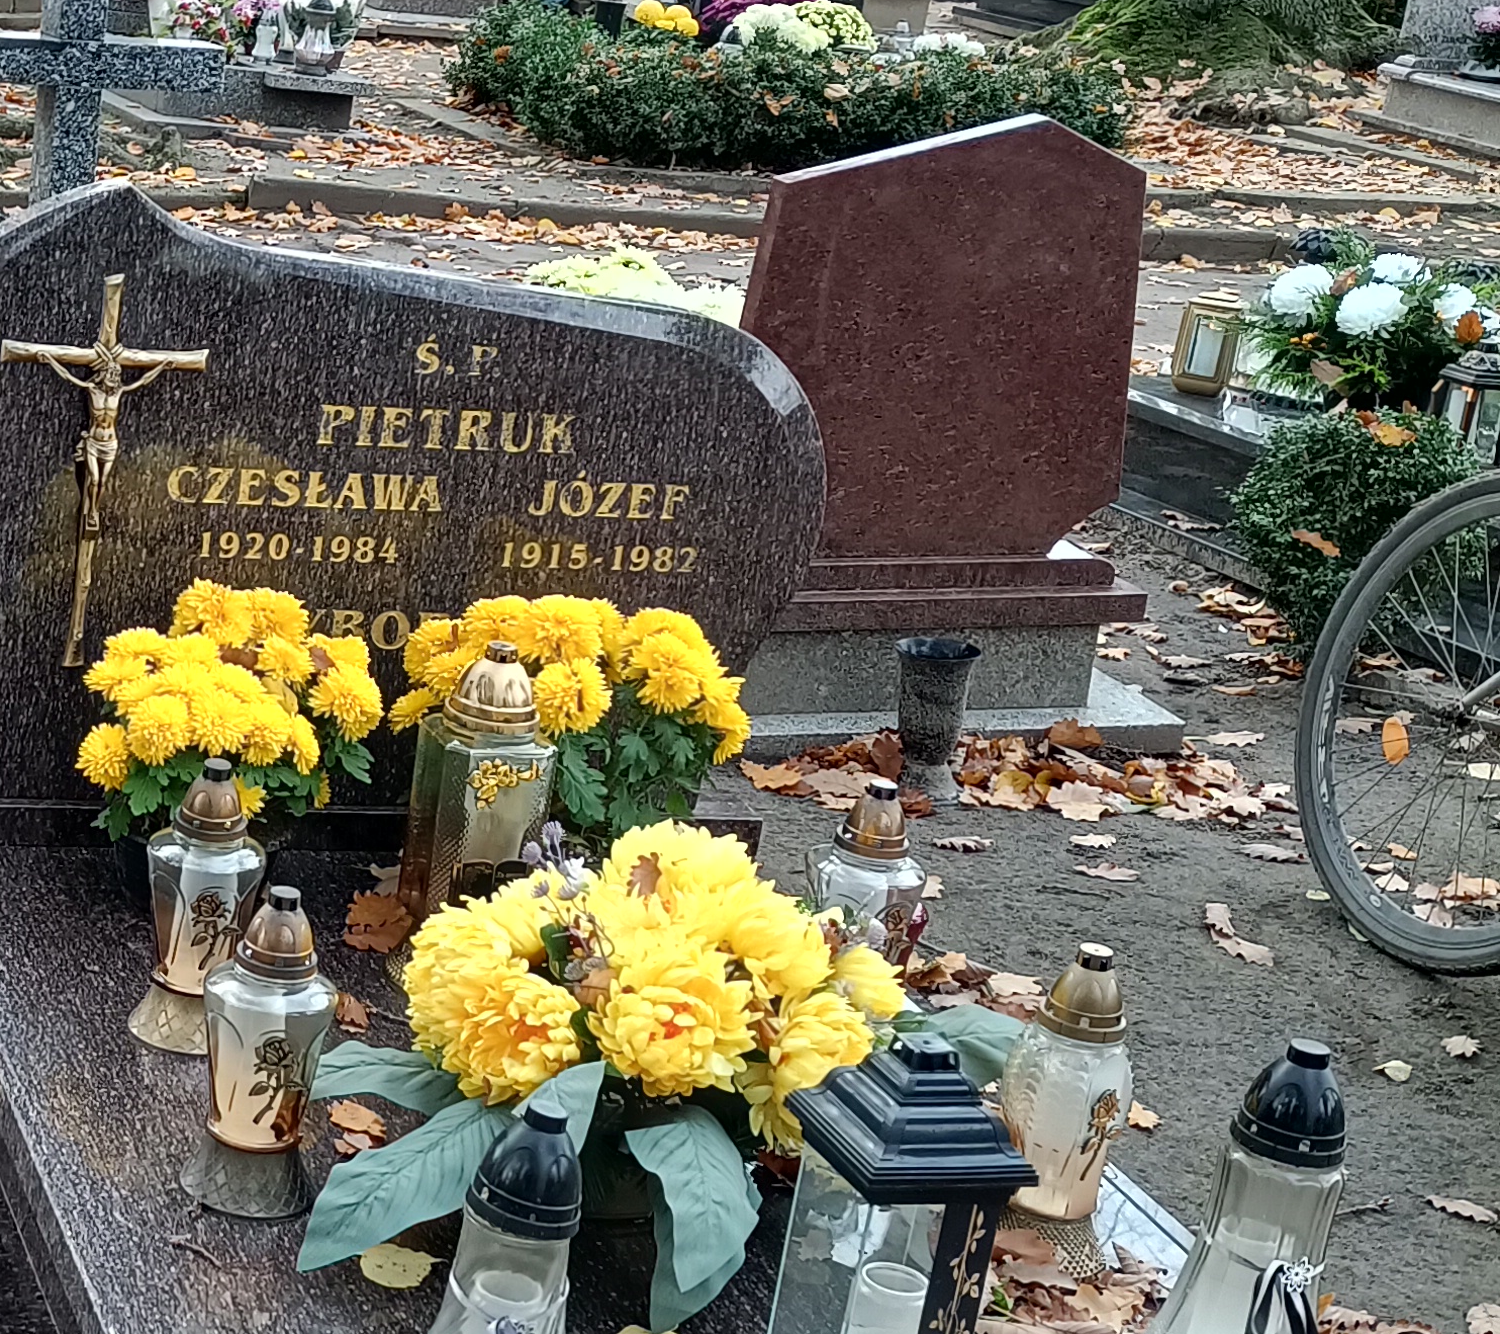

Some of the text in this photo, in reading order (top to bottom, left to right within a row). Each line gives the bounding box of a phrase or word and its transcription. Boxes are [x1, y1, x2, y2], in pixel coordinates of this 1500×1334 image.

[316, 402, 577, 456] PIETRUK
[166, 466, 691, 521] CZESŁAWA JÓZEF
[199, 529, 699, 574] 1920-1984 1915-1982
